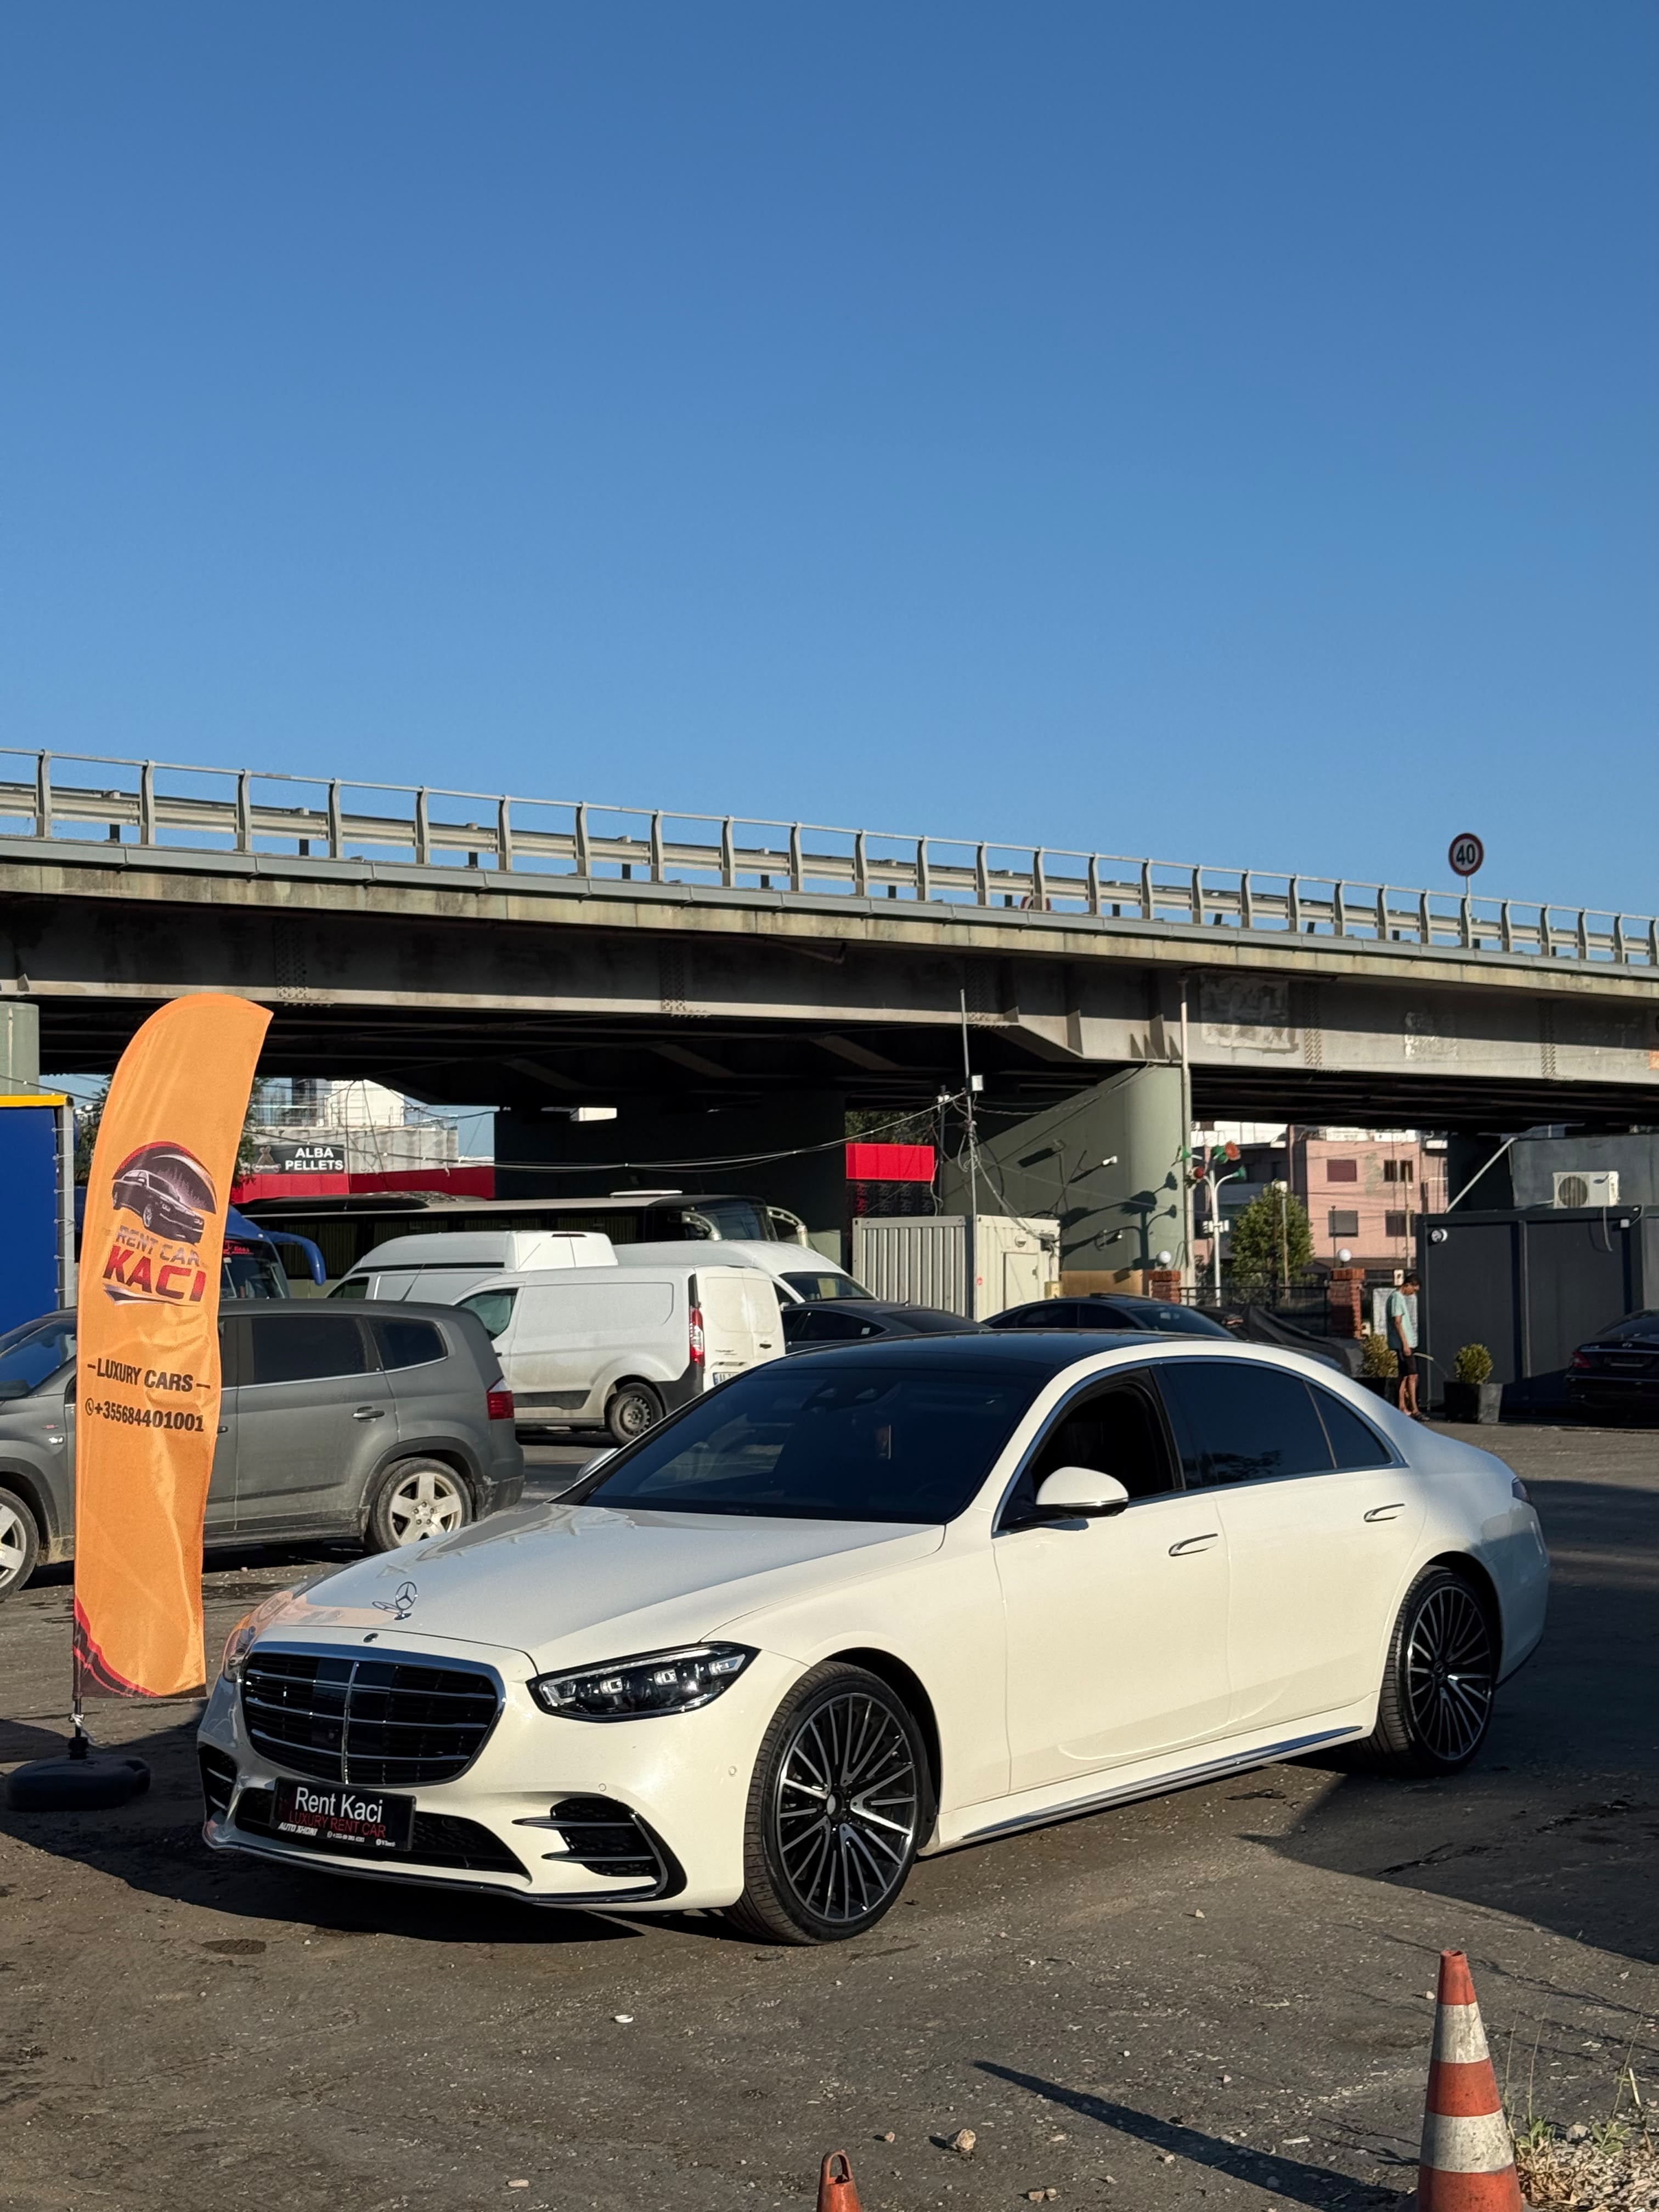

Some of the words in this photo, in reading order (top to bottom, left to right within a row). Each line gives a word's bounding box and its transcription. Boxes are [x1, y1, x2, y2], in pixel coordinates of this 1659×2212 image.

[1457, 844, 1476, 865] 40
[285, 1160, 343, 1171] PELLETS
[295, 1147, 334, 1159] ALBA
[116, 1224, 159, 1255] RENT
[160, 1244, 201, 1267] CAR
[102, 1244, 207, 1302] KACI
[97, 1357, 142, 1386] LUXURY
[144, 1369, 194, 1392] CARS
[95, 1401, 205, 1432] +355684401001
[295, 1786, 336, 1816] Rent
[340, 1793, 383, 1823] Kaci
[278, 1822, 297, 1833] AUTO
[289, 1810, 329, 1829] LUXURY
[330, 1817, 360, 1833] RENT
[362, 1822, 386, 1838] CAR
